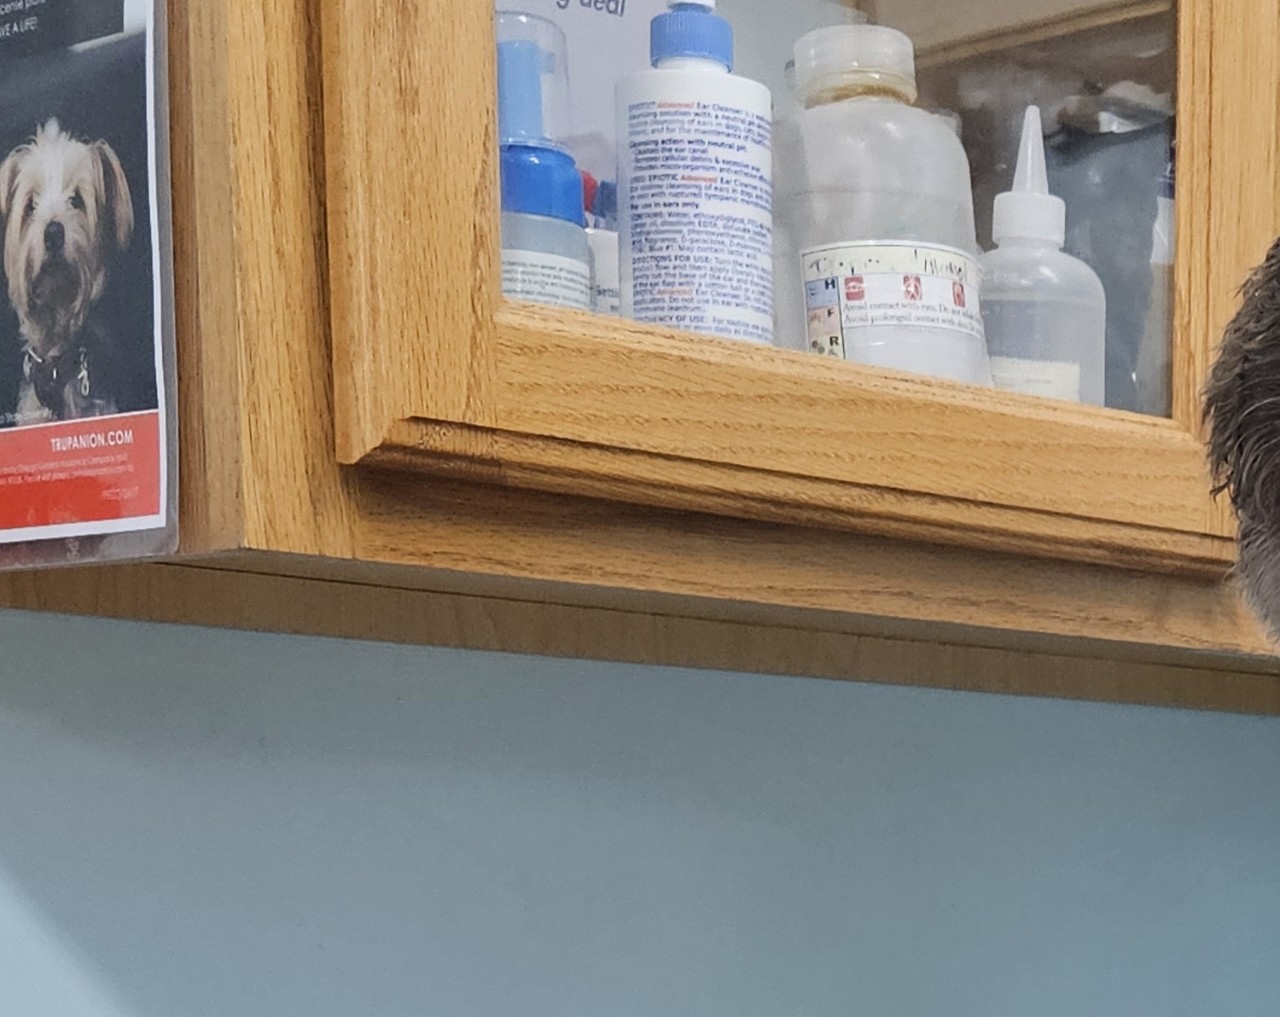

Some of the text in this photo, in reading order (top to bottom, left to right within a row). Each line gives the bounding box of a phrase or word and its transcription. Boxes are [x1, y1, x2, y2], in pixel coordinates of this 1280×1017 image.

[825, 279, 836, 290] H
[830, 336, 839, 346] R
[51, 429, 133, 452] TRUPANION.COM
